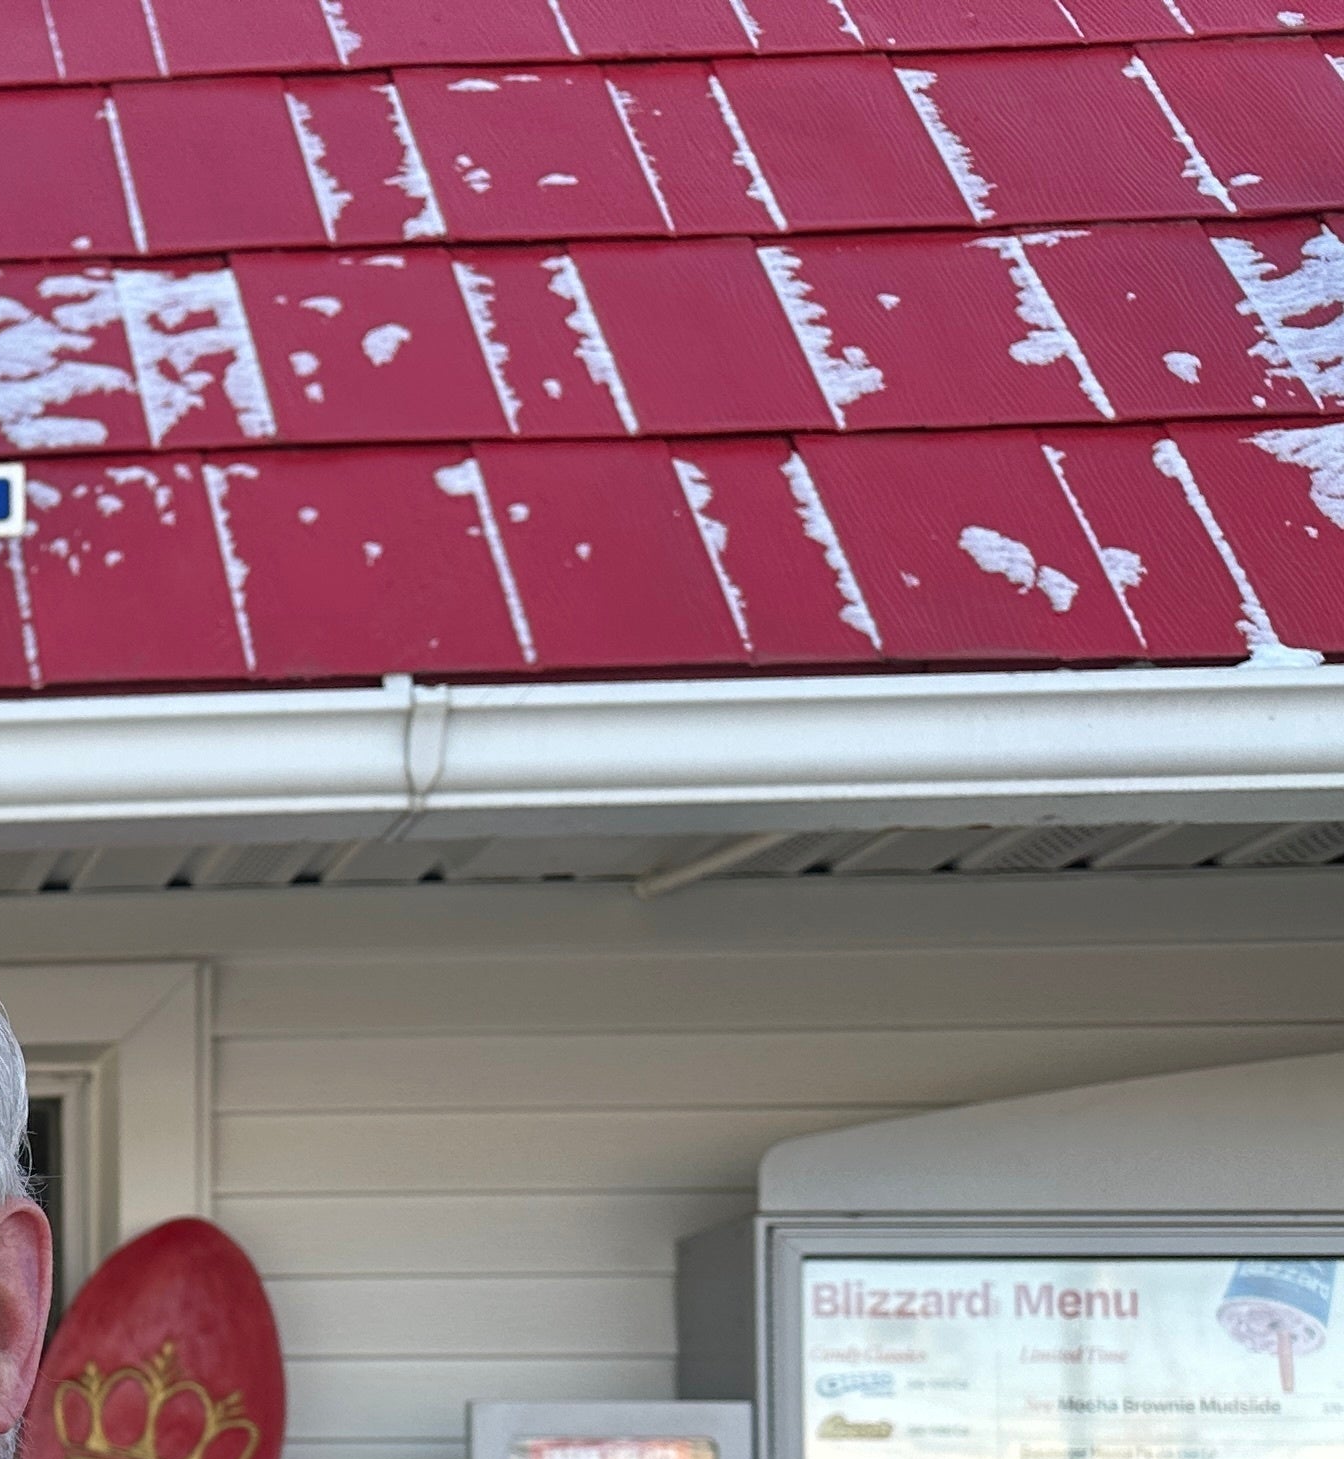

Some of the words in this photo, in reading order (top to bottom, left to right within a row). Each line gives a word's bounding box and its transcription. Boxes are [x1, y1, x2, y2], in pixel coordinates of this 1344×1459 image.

[811, 1279, 993, 1318] Blizzard
[1014, 1282, 1140, 1320] Menu
[1123, 1397, 1195, 1414] Brownie
[1199, 1397, 1282, 1415] Mudslide
